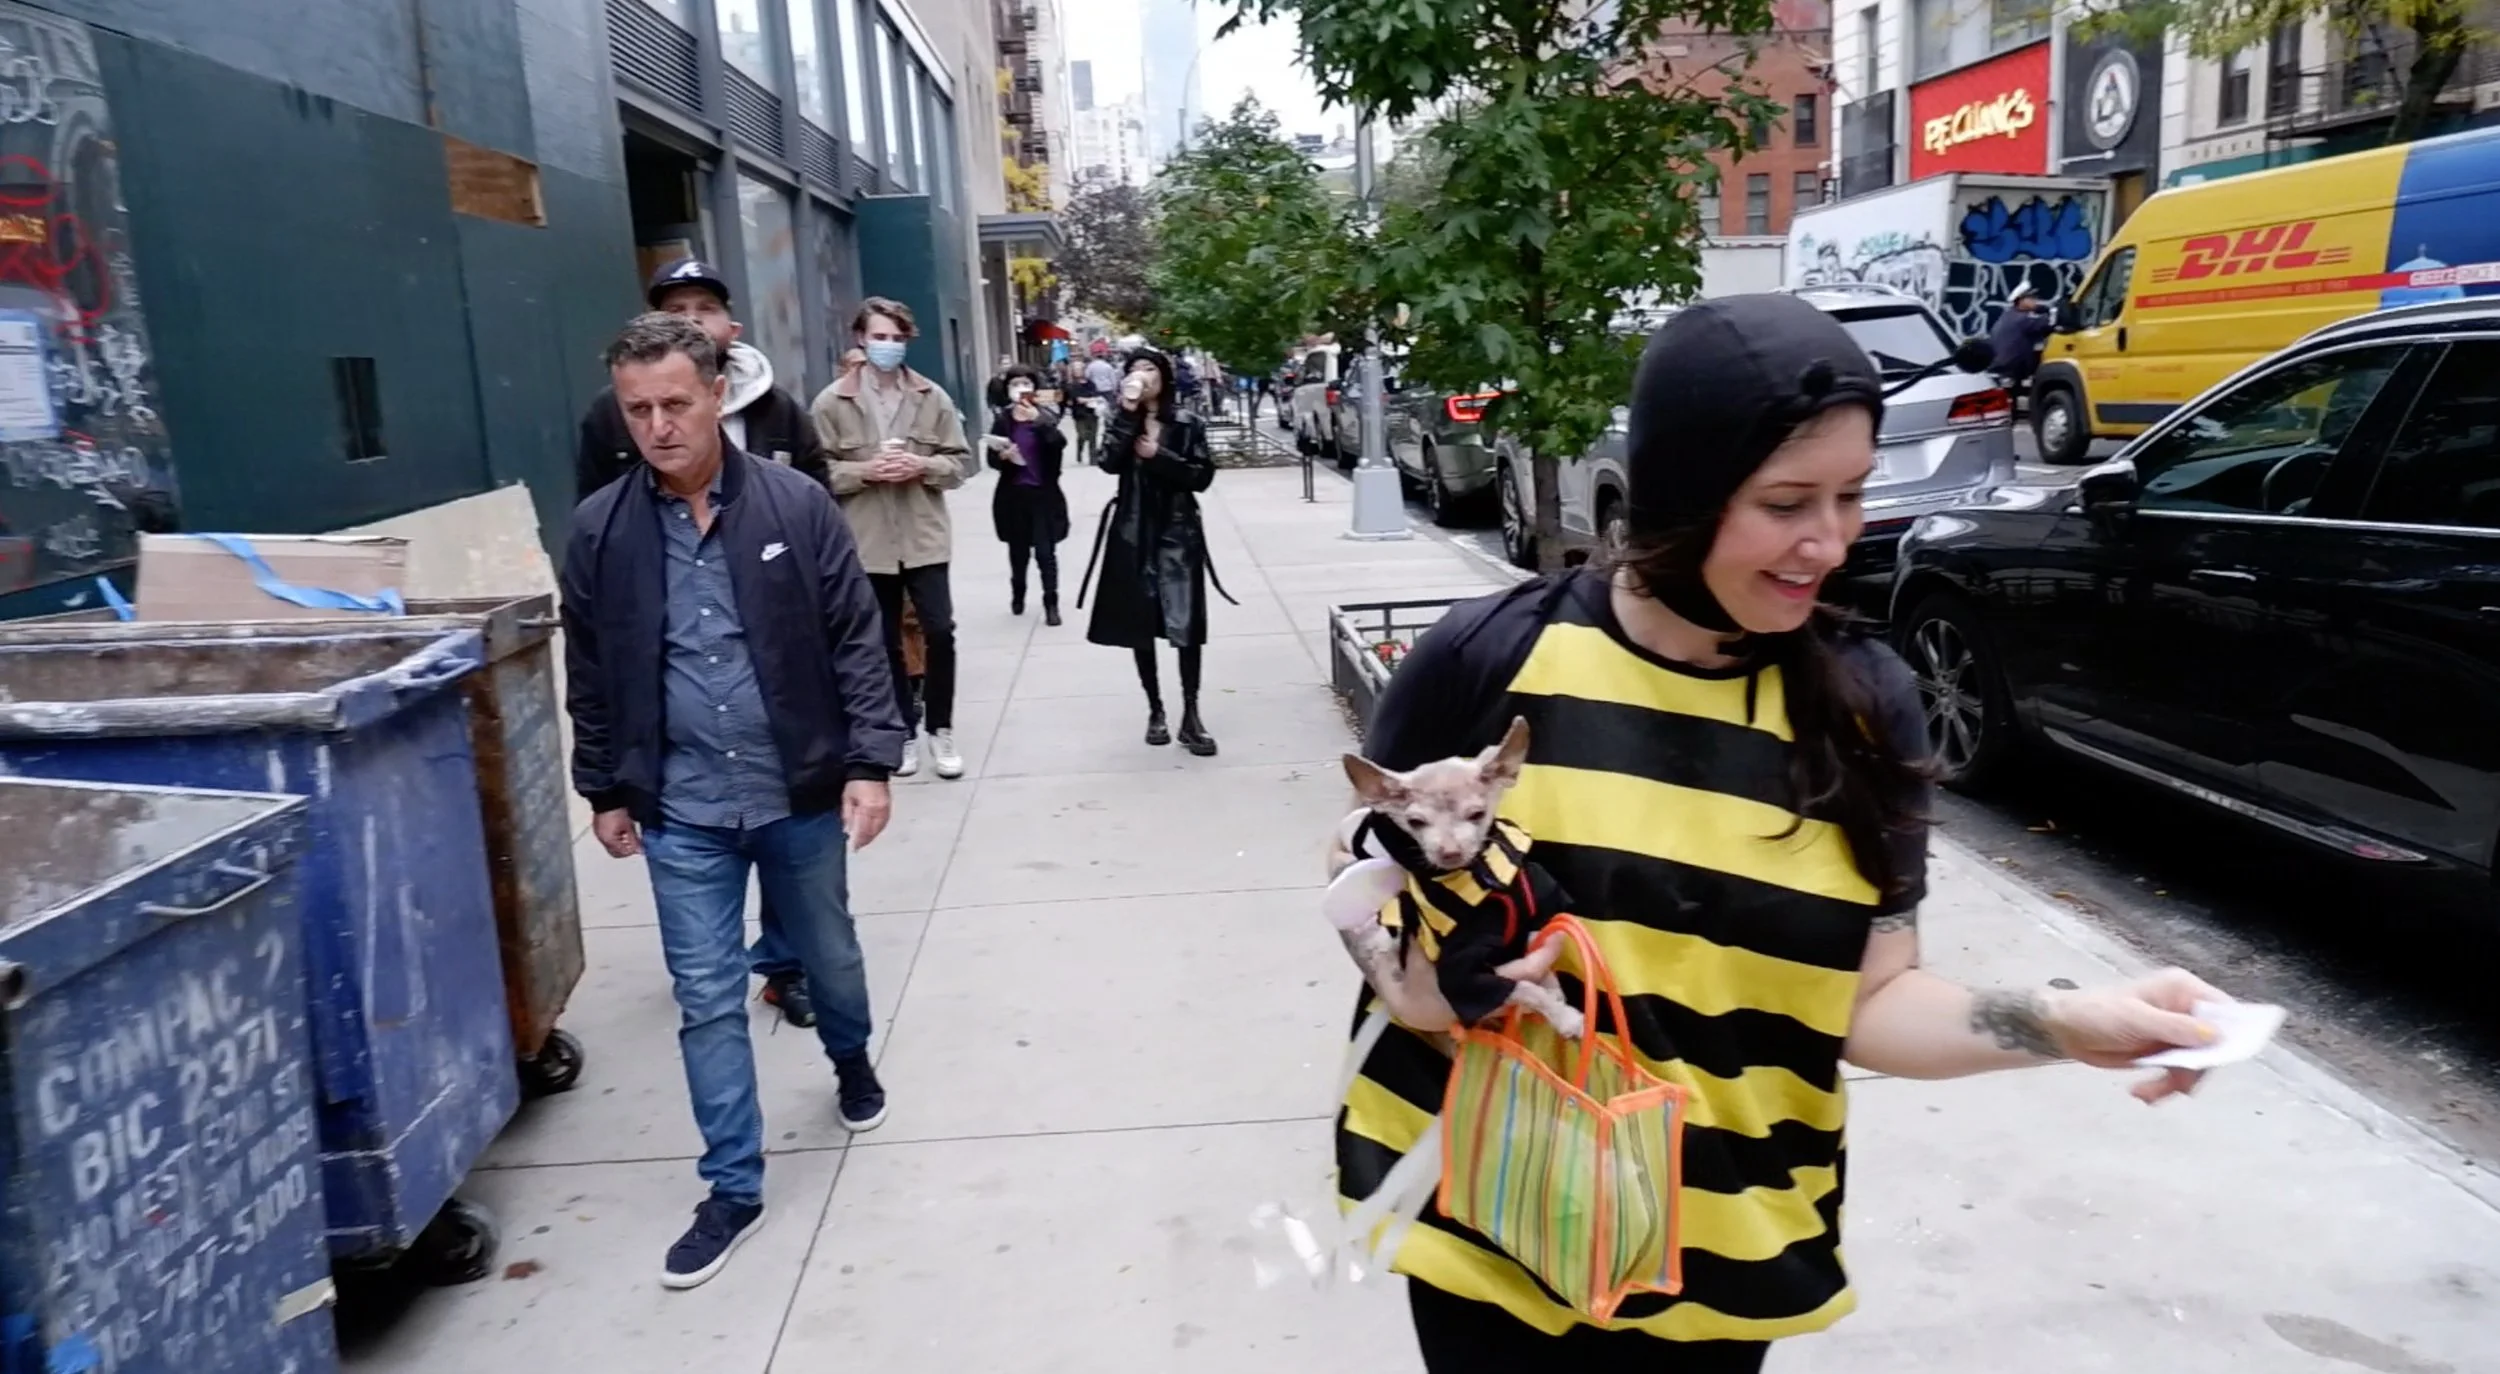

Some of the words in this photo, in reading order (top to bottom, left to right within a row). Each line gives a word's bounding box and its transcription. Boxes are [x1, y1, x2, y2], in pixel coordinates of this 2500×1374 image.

[2175, 221, 2317, 280] DHL
[70, 1092, 163, 1202] BIC
[178, 1005, 279, 1126] 2371
